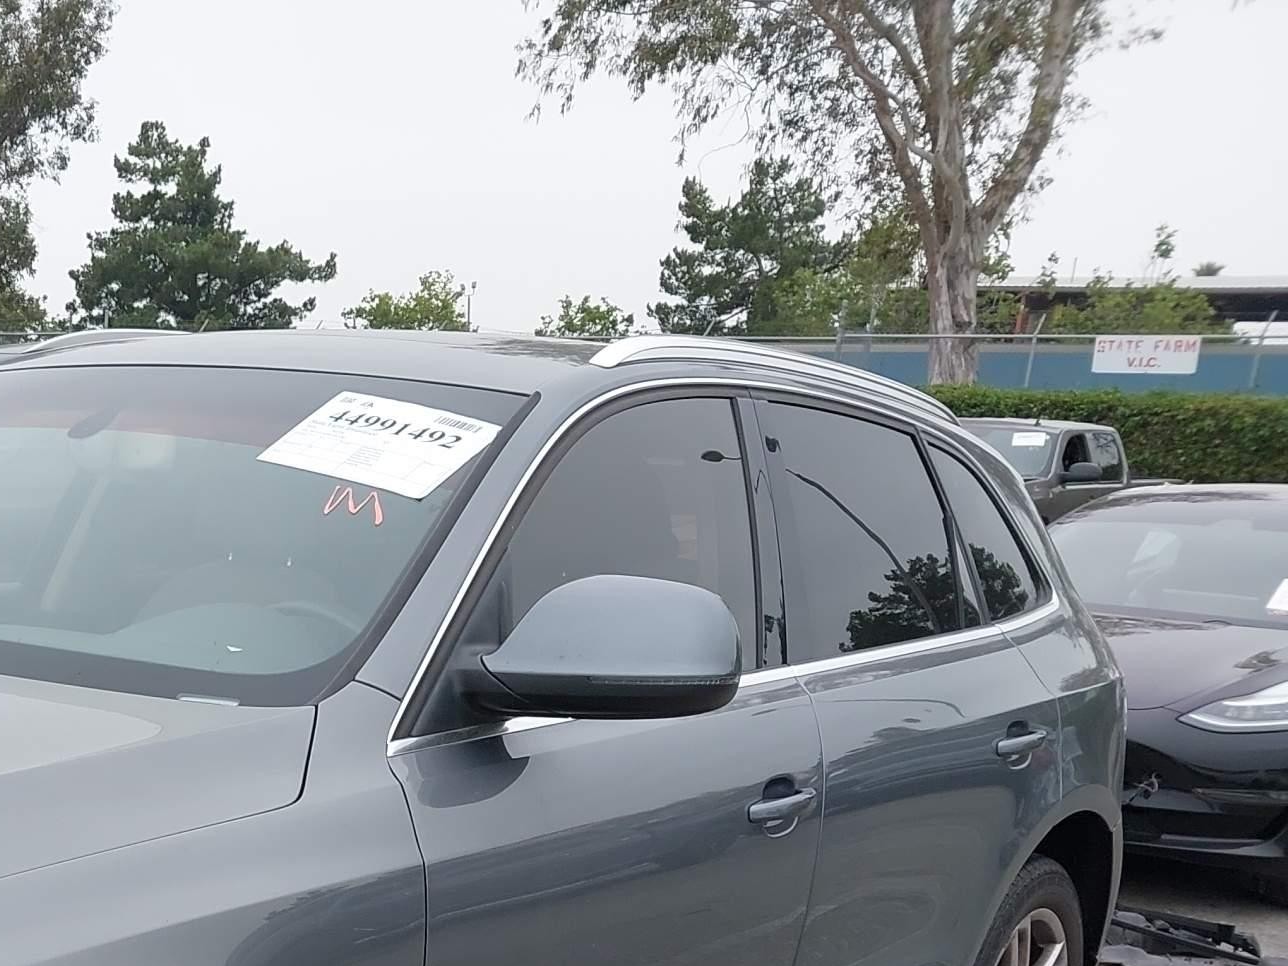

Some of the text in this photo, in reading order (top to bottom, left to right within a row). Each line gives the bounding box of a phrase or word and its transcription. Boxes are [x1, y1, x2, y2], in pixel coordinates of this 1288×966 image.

[1097, 340, 1198, 353] STATE FARM
[1127, 357, 1161, 368] V.I.C.
[329, 410, 462, 449] 44991492
